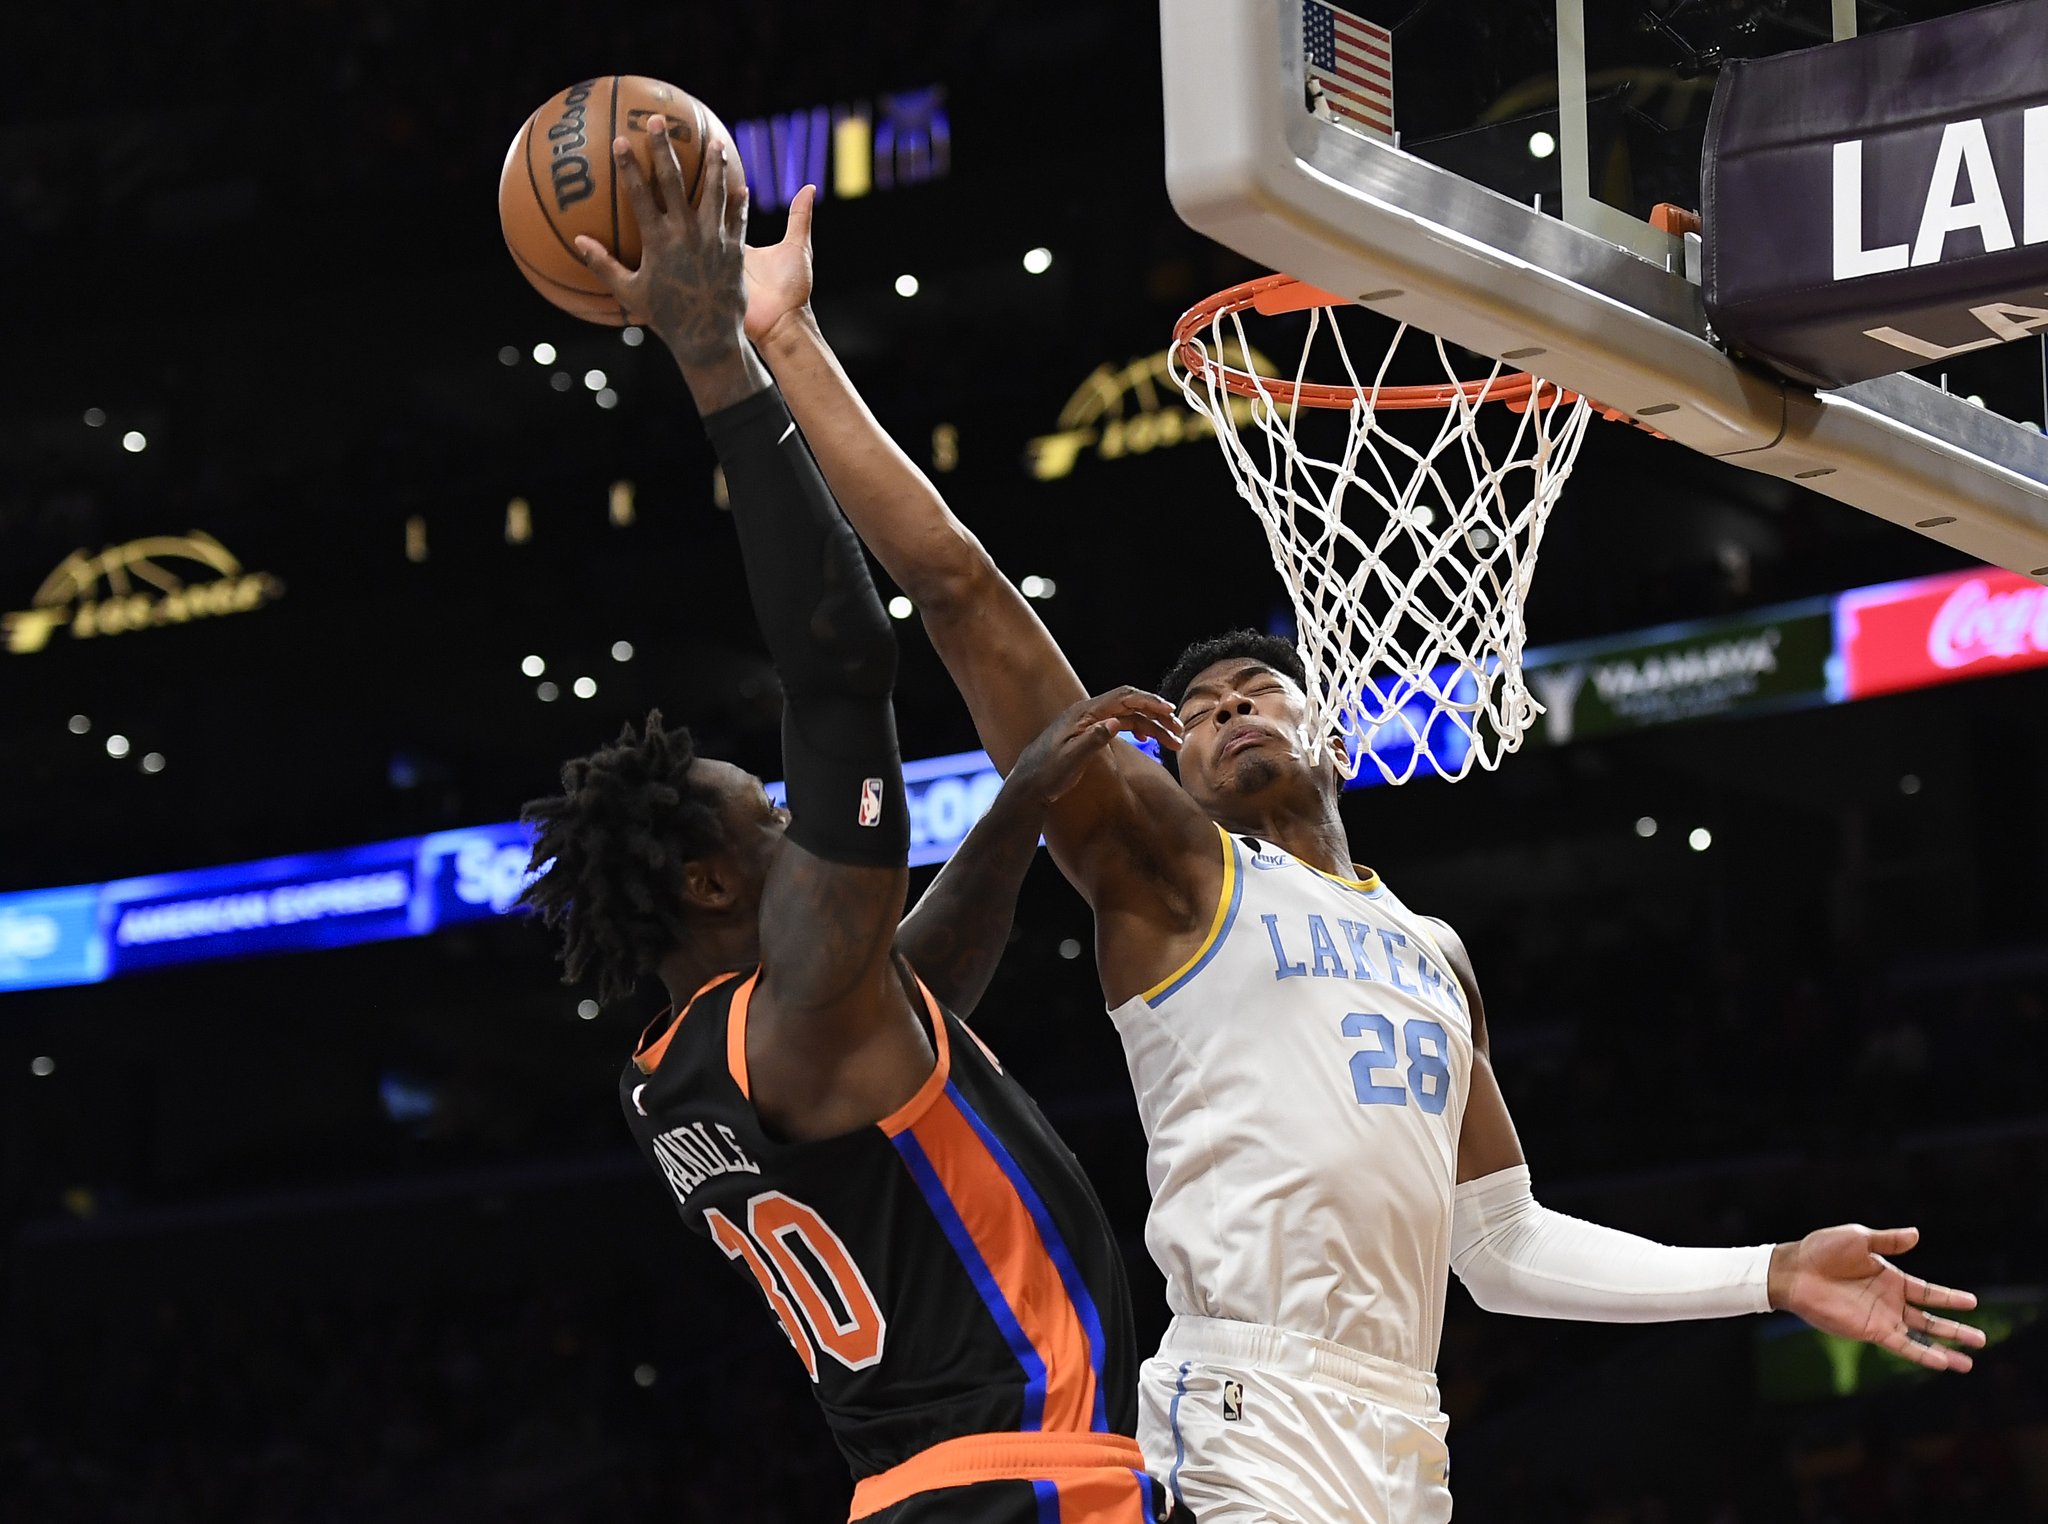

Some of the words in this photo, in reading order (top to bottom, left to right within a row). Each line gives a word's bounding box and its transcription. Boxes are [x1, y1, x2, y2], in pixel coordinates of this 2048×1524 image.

[1833, 104, 2048, 281] LA
[1341, 1012, 1450, 1115] 28
[652, 1122, 761, 1204] RANDLE
